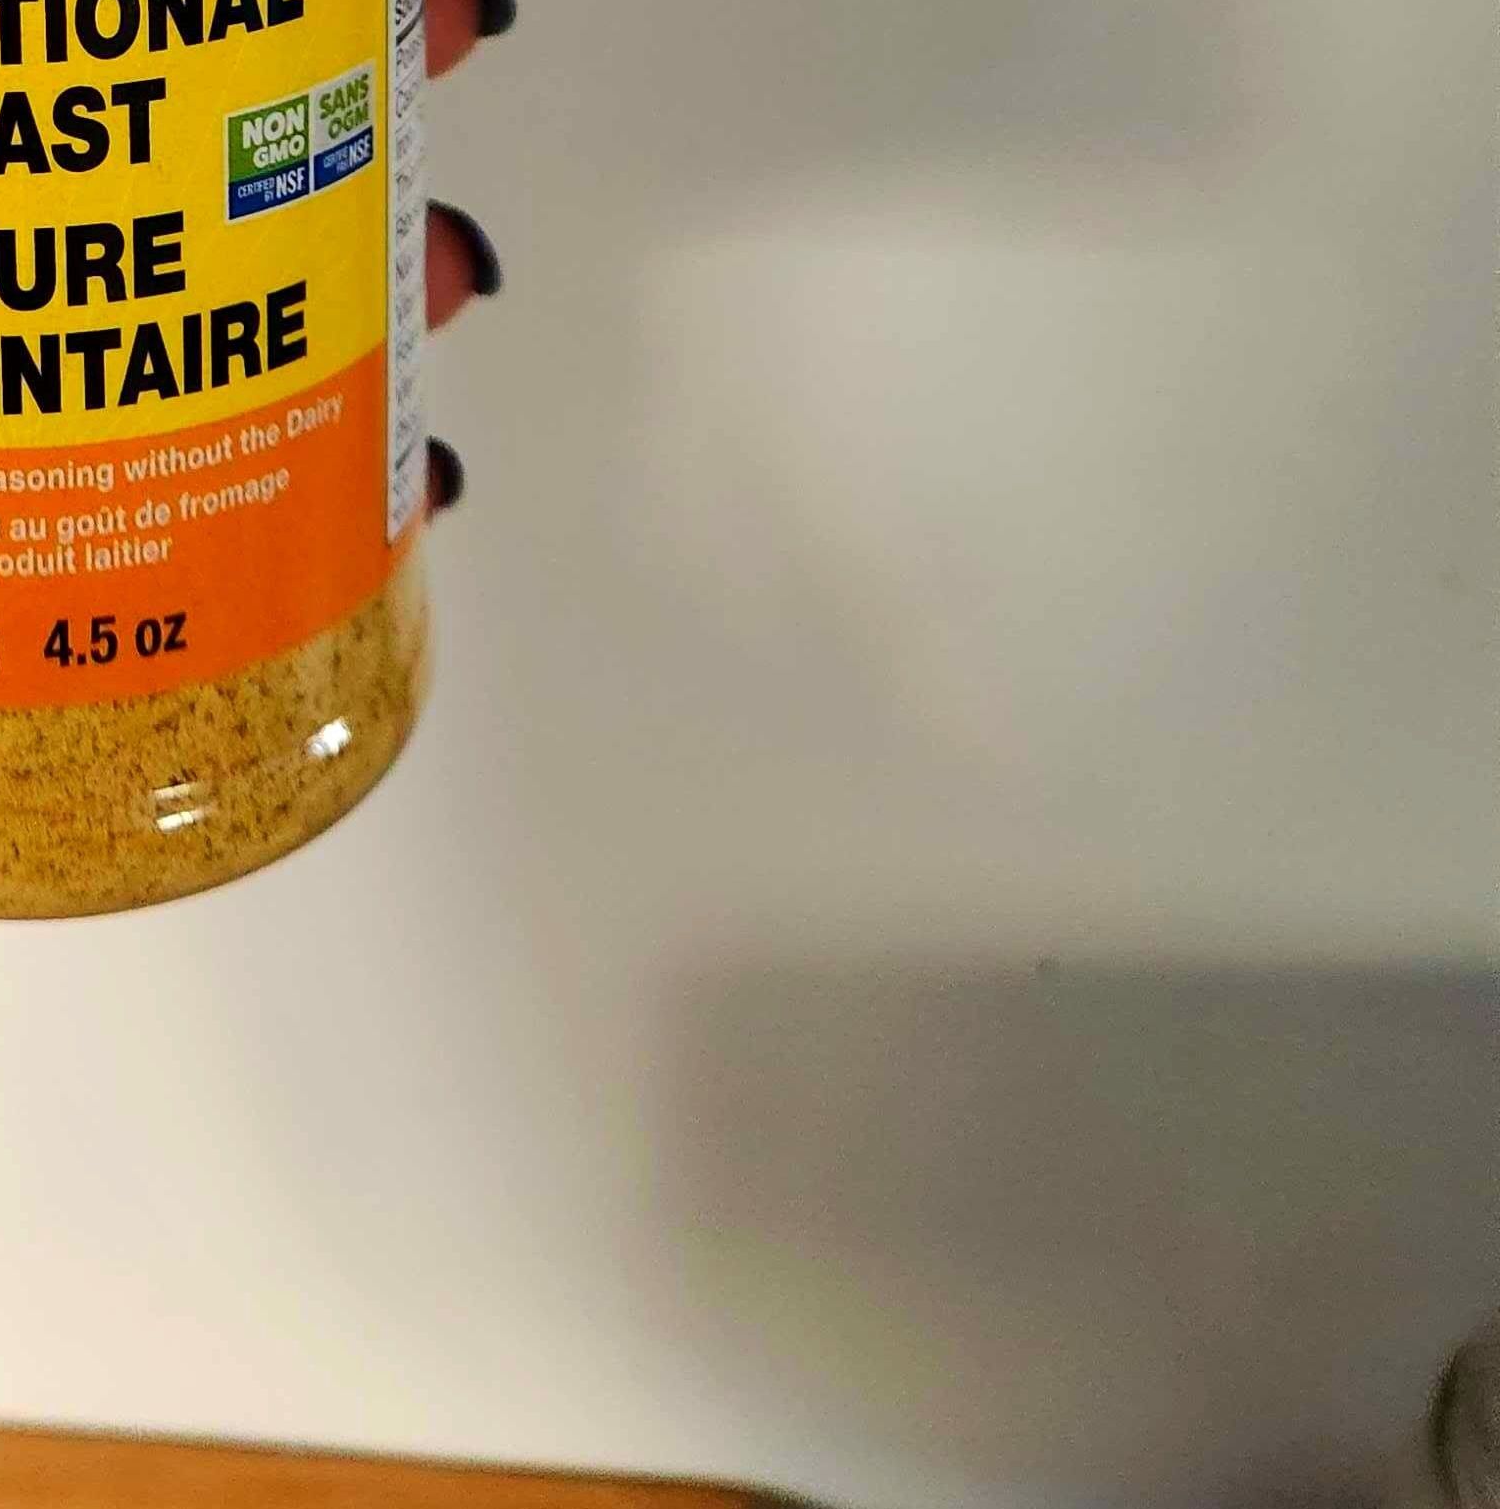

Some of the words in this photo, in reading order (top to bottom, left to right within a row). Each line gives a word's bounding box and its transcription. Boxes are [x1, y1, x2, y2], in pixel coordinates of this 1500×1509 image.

[318, 72, 370, 120] SANS
[242, 103, 305, 149] NON
[327, 99, 370, 140] OGM
[252, 134, 305, 169] GMO
[237, 176, 275, 199] CERTIFIED
[276, 166, 306, 198] NSF
[123, 434, 233, 483] without
[239, 420, 282, 456] the
[286, 392, 344, 439] Dairy
[8, 515, 47, 542] au
[55, 505, 127, 545] goût
[134, 499, 171, 530] de
[178, 466, 291, 522] fromage
[84, 534, 173, 573] laitier
[42, 617, 119, 667] 4.5
[134, 611, 188, 656] oz
